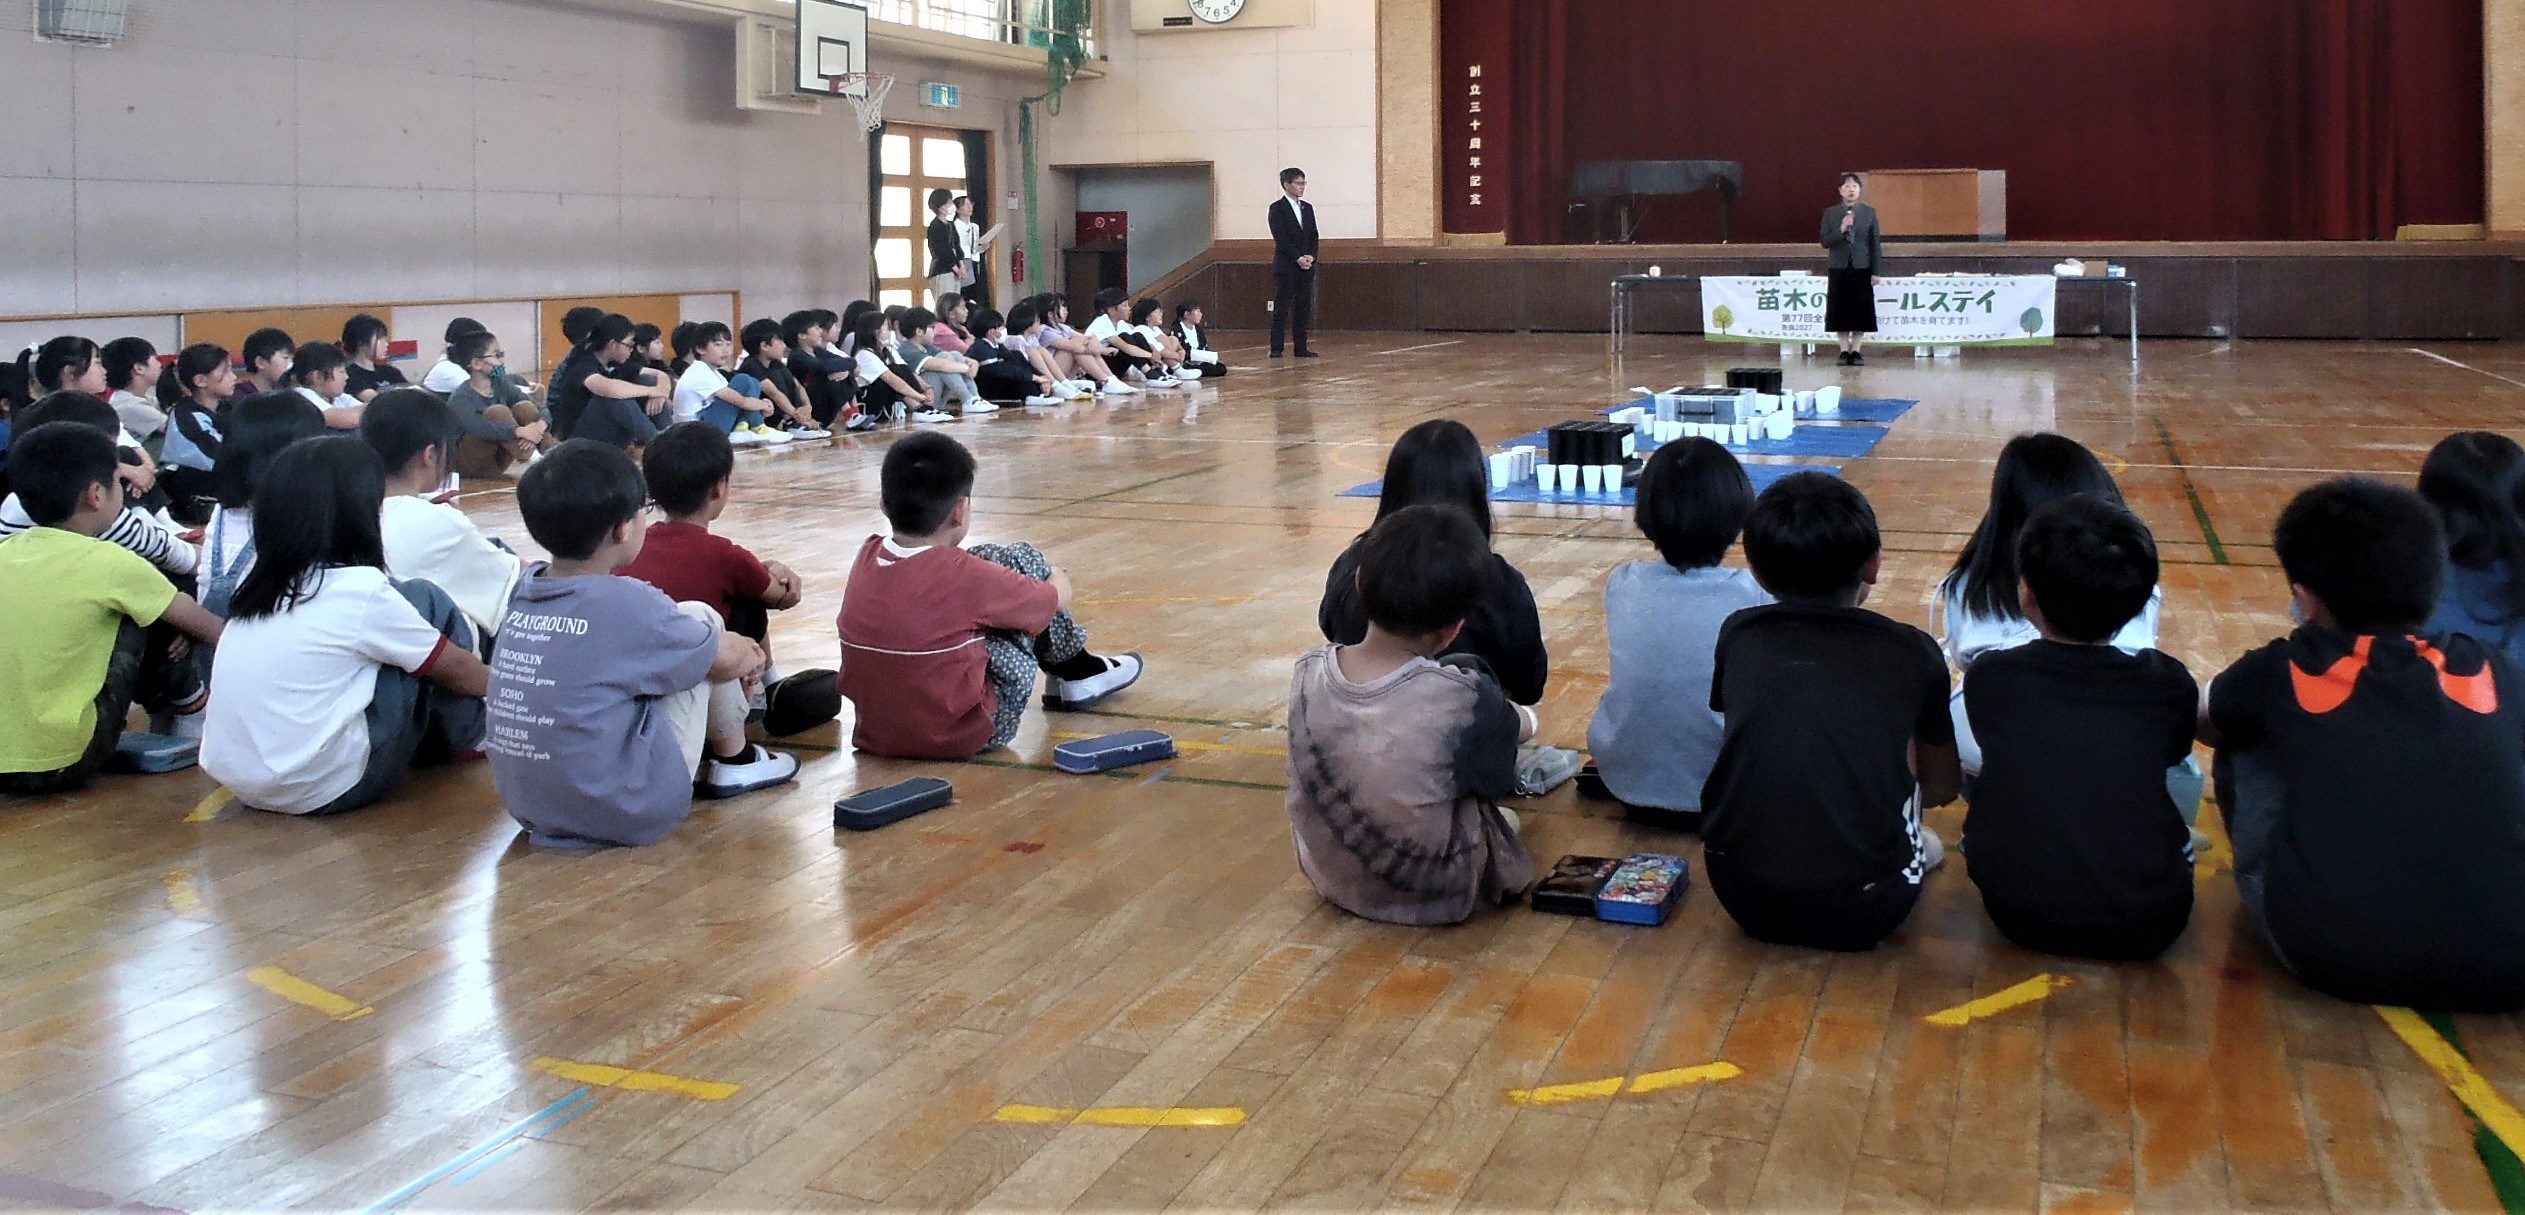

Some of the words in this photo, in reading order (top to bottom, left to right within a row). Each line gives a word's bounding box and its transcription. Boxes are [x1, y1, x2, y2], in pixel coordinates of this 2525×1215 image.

[1205, 7, 1211, 15] 7
[1213, 8, 1220, 17] 6
[1223, 5, 1230, 14] 5
[506, 611, 588, 635] PLAYGROUND
[500, 647, 544, 665] BROOKLYN
[535, 678, 557, 687] grow
[500, 688, 524, 701] SOHO
[537, 714, 556, 727] play
[495, 724, 529, 741] HARLEM
